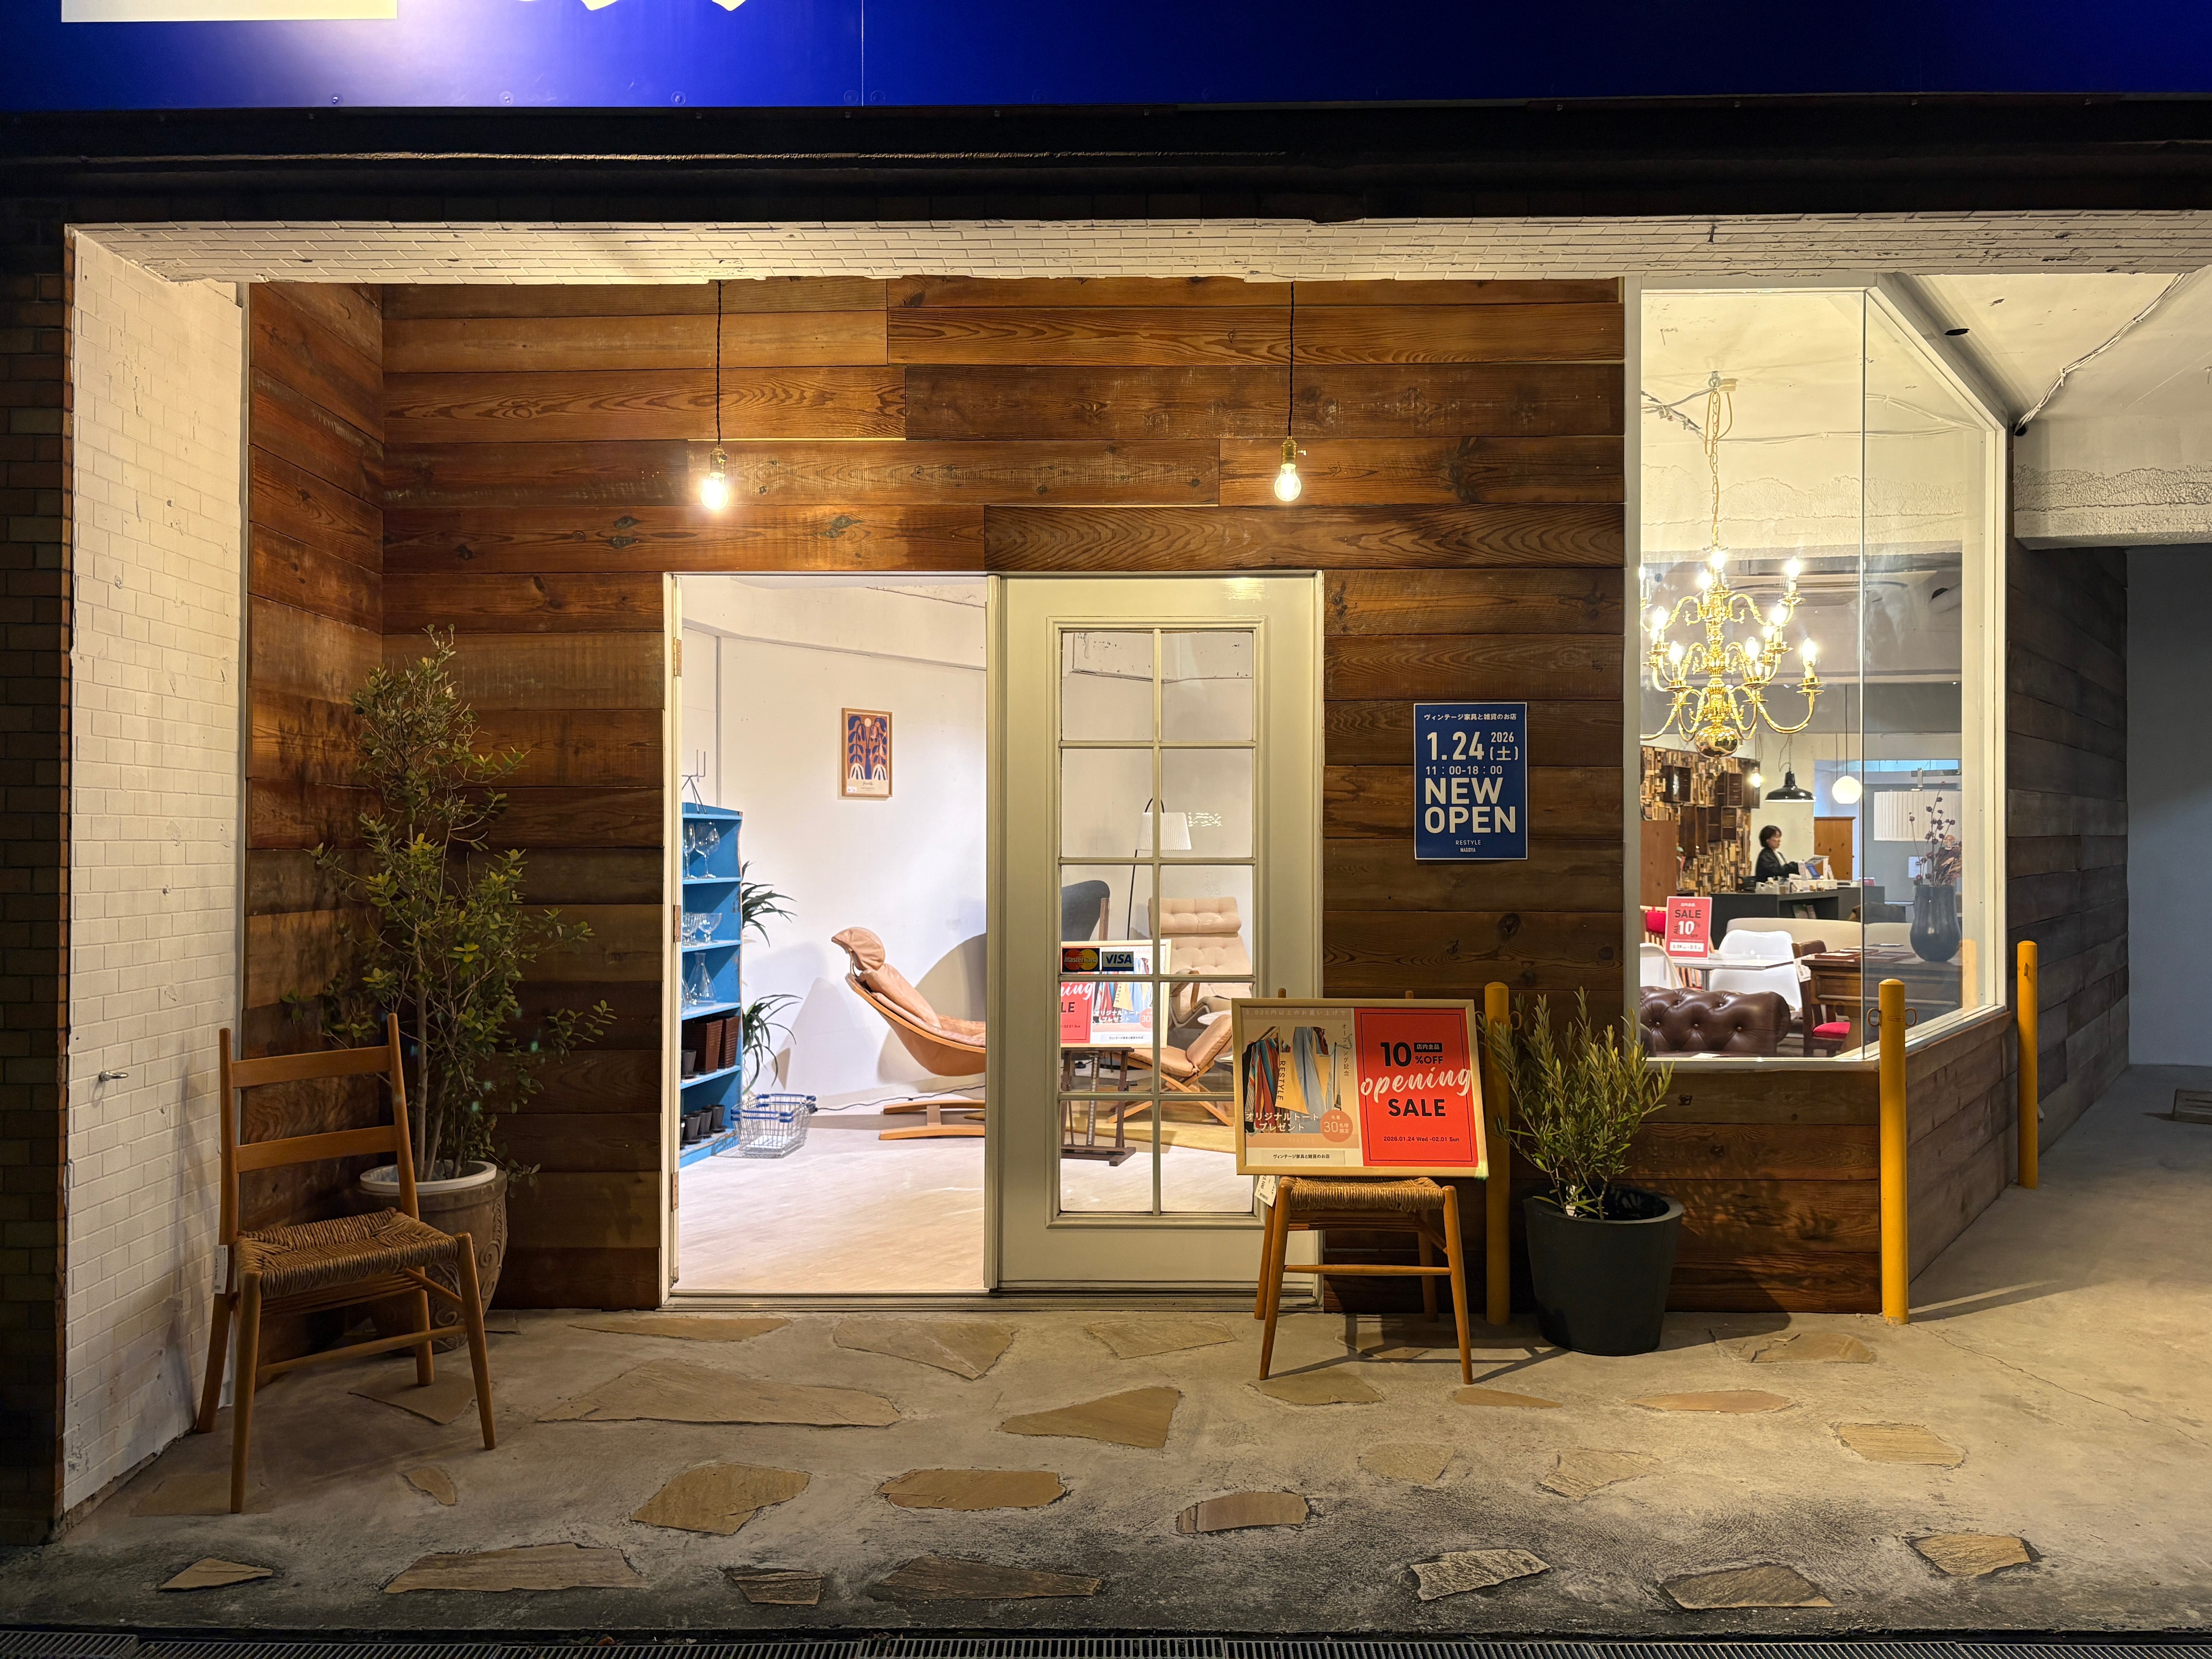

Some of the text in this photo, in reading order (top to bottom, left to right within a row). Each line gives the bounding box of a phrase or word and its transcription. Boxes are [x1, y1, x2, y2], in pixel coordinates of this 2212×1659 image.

[1427, 731, 1514, 761] 1.24 2026
[1490, 746, 1518, 761] (土)
[1425, 777, 1503, 804] NEW
[1425, 806, 1515, 834] OPEN
[1675, 910, 1701, 918] SALE
[1678, 921, 1695, 935] 10
[1106, 954, 1132, 964] VISA
[1061, 1002, 1075, 1013] LE
[1380, 1042, 1412, 1067] 10
[1415, 1056, 1443, 1064] %OFF
[1277, 1061, 1286, 1101] RESTYLE
[1360, 1066, 1471, 1103] opening
[1388, 1098, 1446, 1116] SALE
[1245, 1112, 1319, 1121] オリジナルトート
[1259, 1122, 1305, 1132] プレゼント
